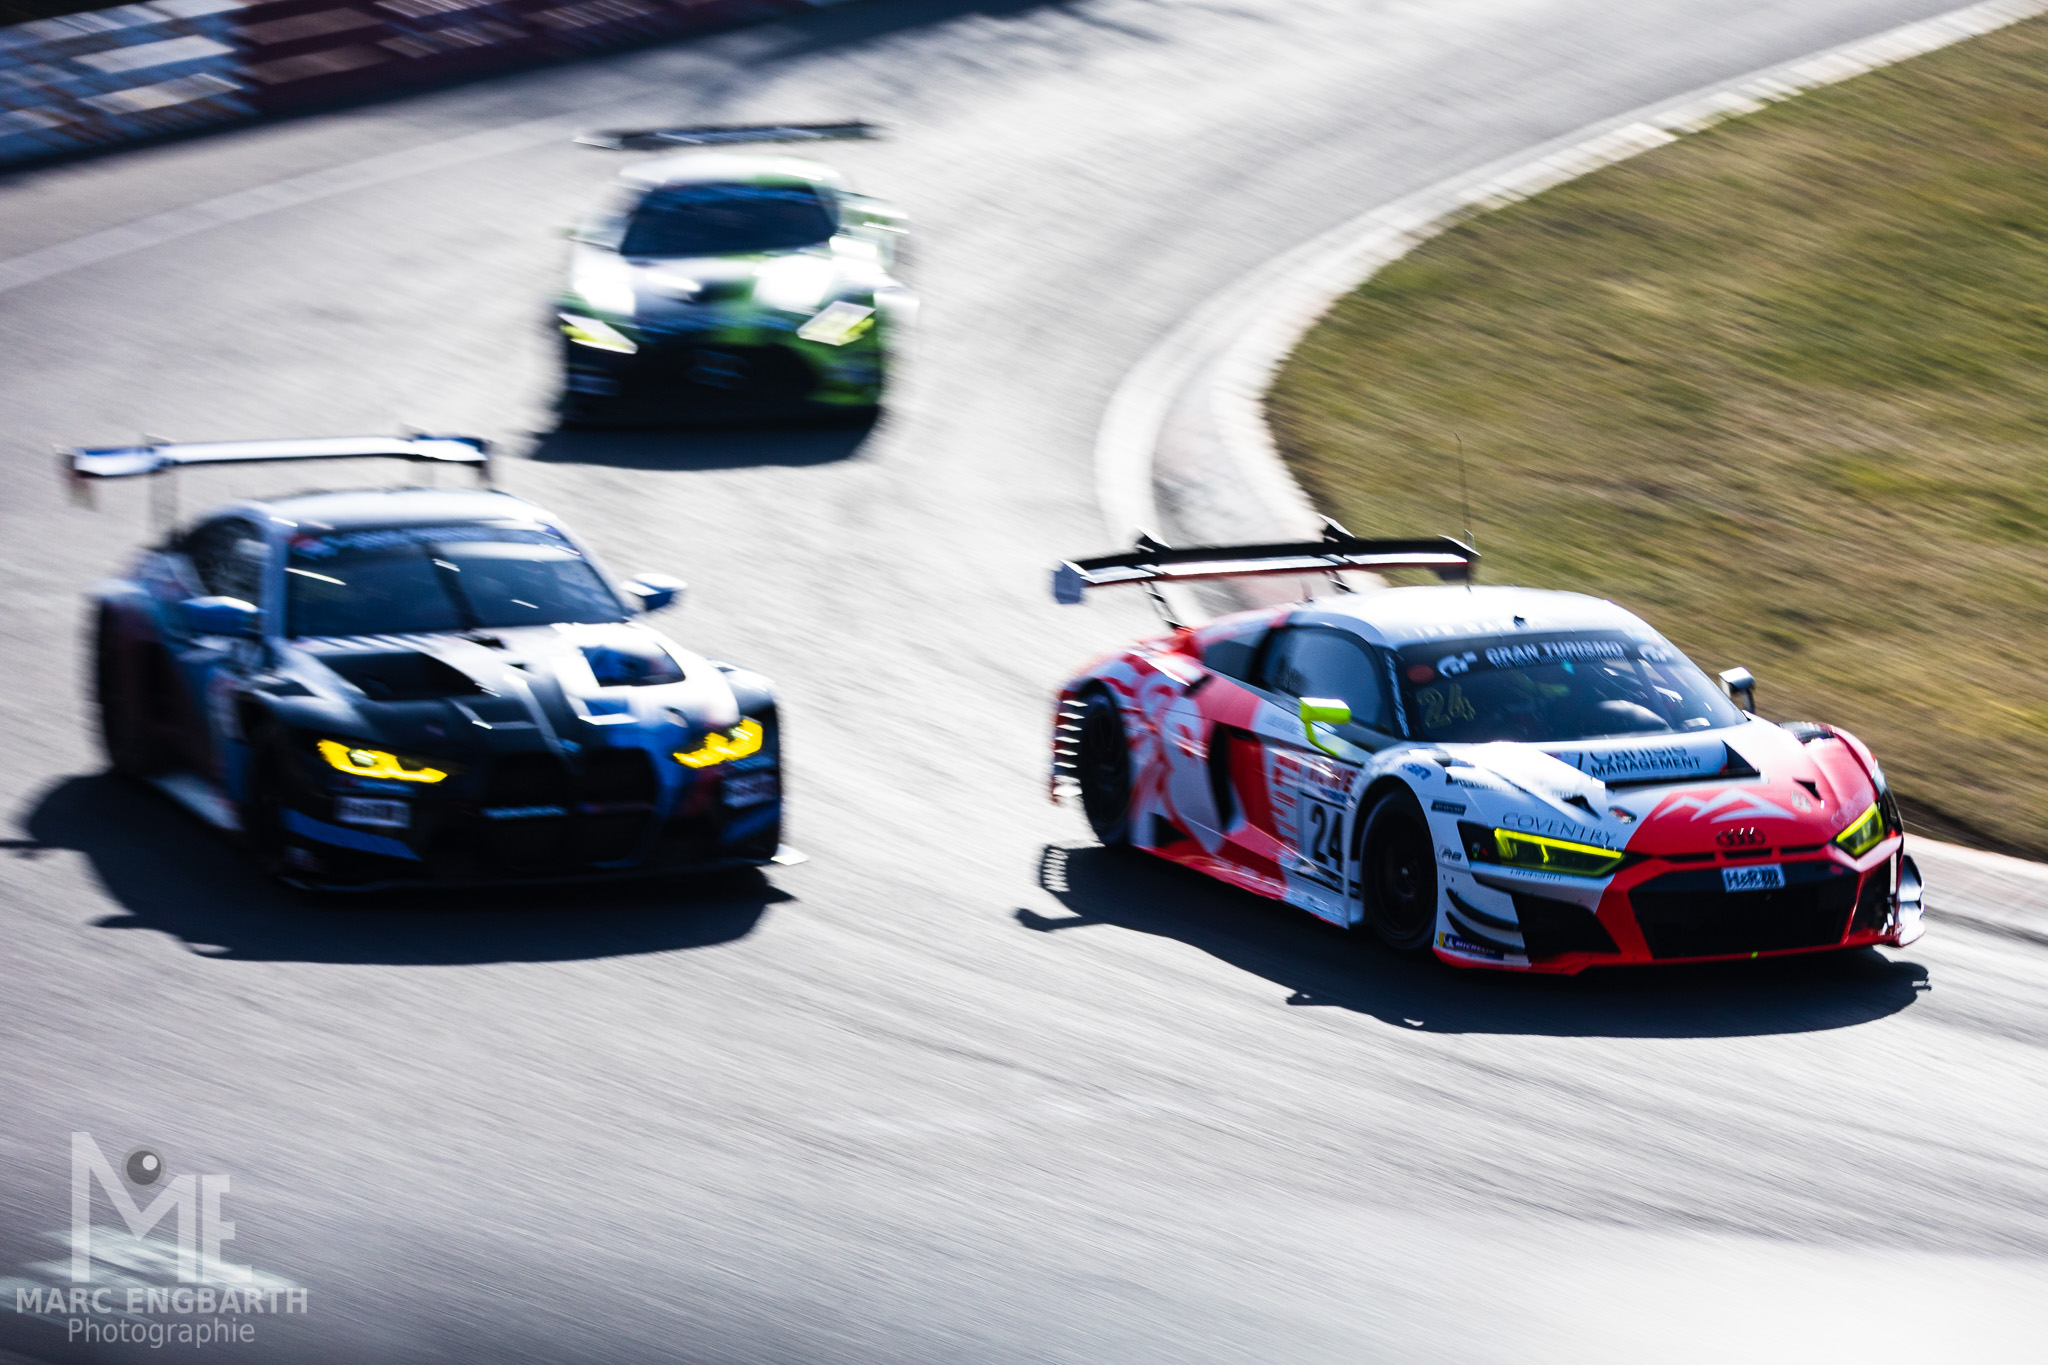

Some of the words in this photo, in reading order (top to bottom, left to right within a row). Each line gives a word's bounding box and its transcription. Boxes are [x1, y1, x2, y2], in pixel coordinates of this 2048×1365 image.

[1485, 643, 1540, 669] GRAN
[1540, 640, 1627, 663] TURISMO
[1416, 683, 1476, 728] 24
[1591, 756, 1700, 777] MANAGEMENT
[1310, 803, 1344, 873] 24
[1502, 811, 1617, 845] COVENTRY
